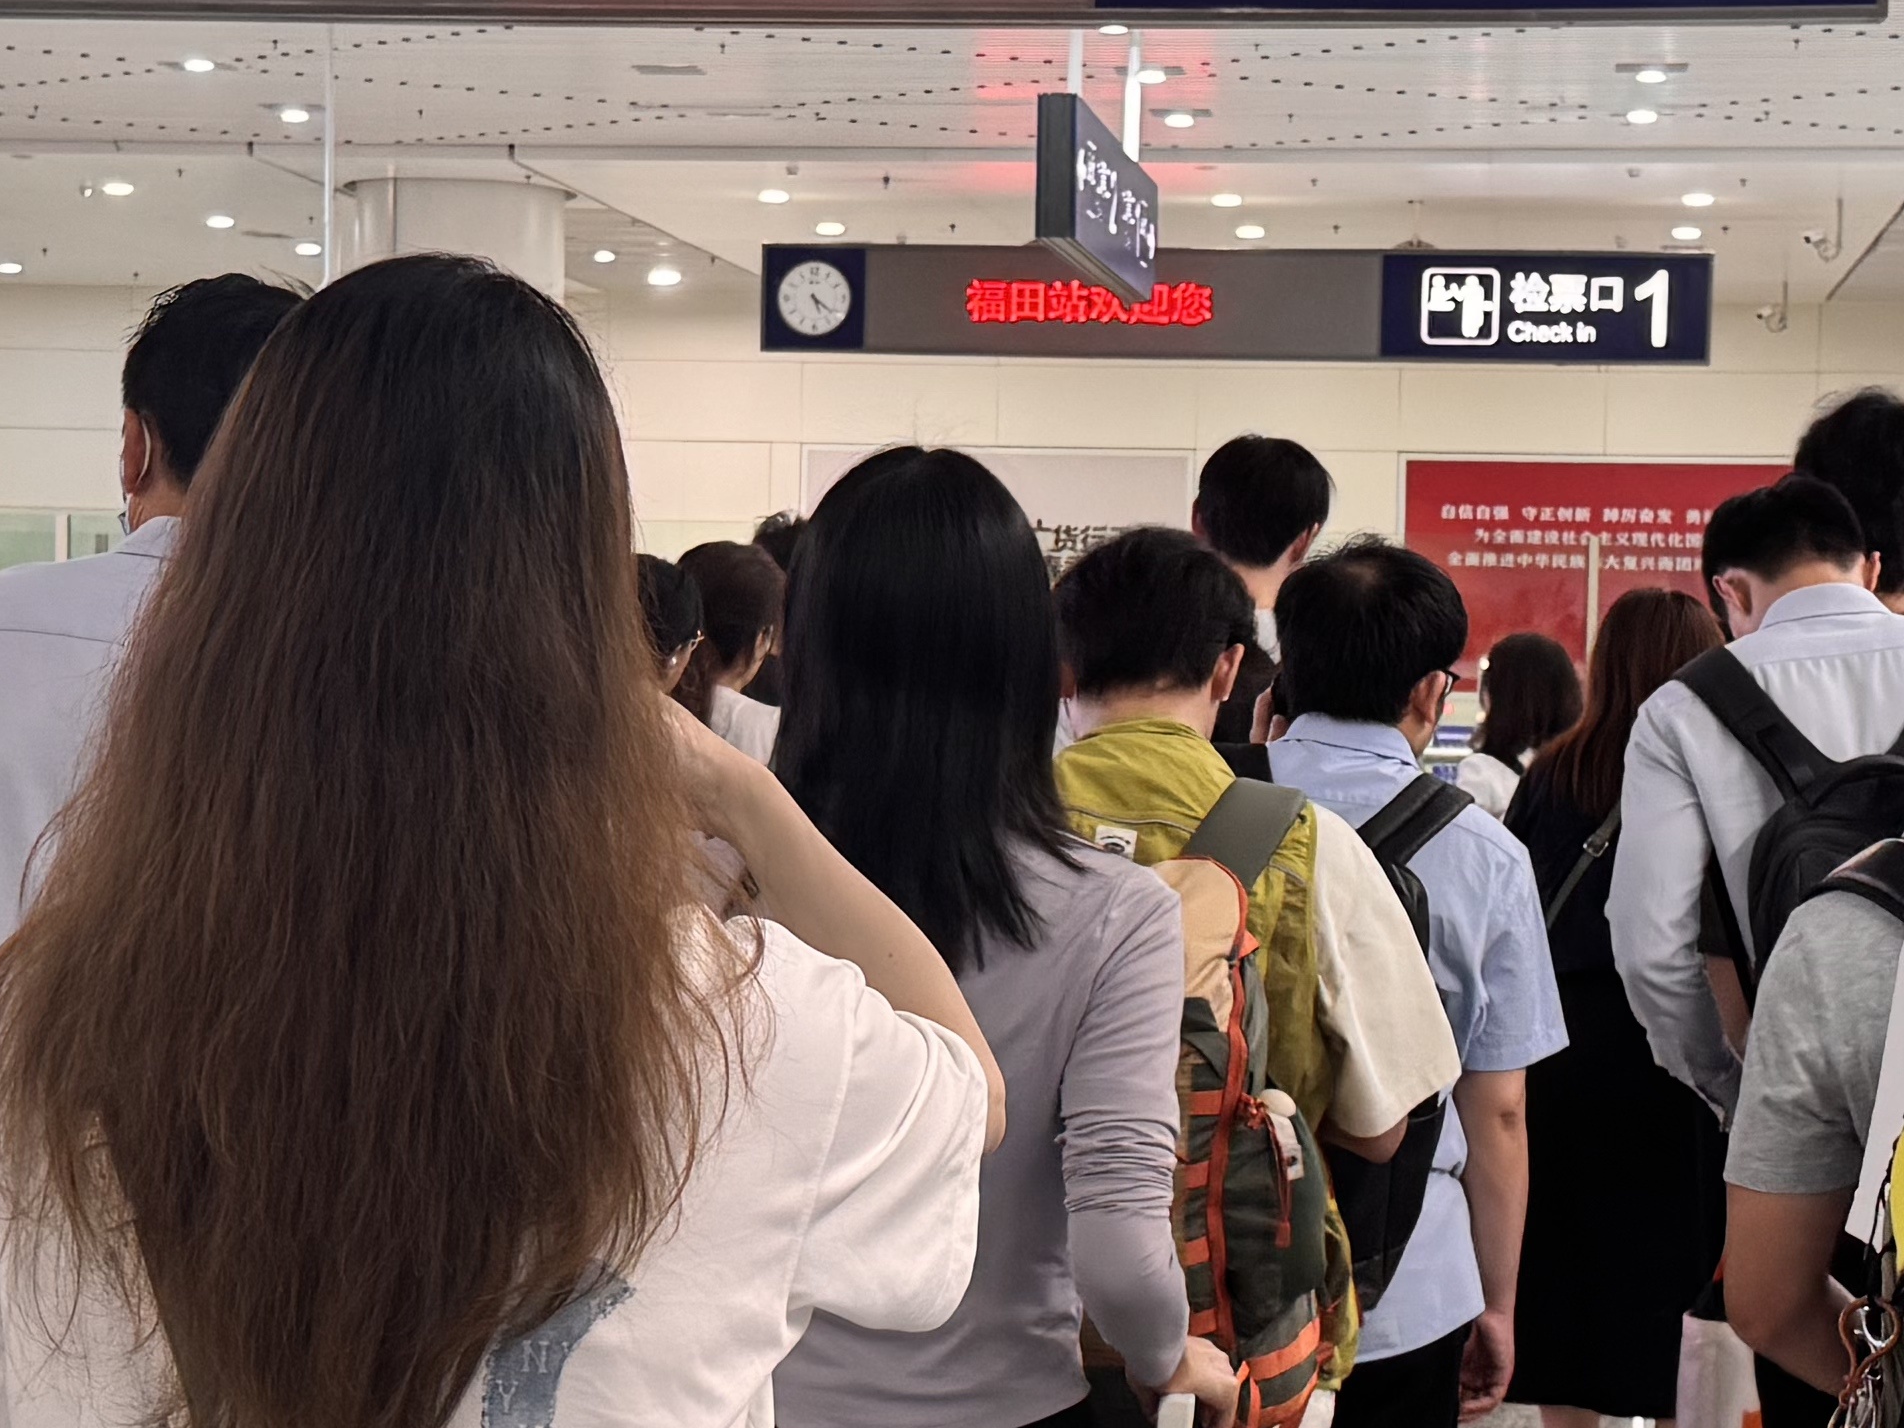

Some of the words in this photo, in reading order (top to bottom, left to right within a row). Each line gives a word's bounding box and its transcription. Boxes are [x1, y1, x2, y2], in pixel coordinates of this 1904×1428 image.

[966, 279, 1213, 326] 福田站欢迎您
[1508, 272, 1624, 314] 检票口
[1634, 269, 1669, 348] 1
[1507, 320, 1573, 343] Check
[1576, 321, 1596, 343] in
